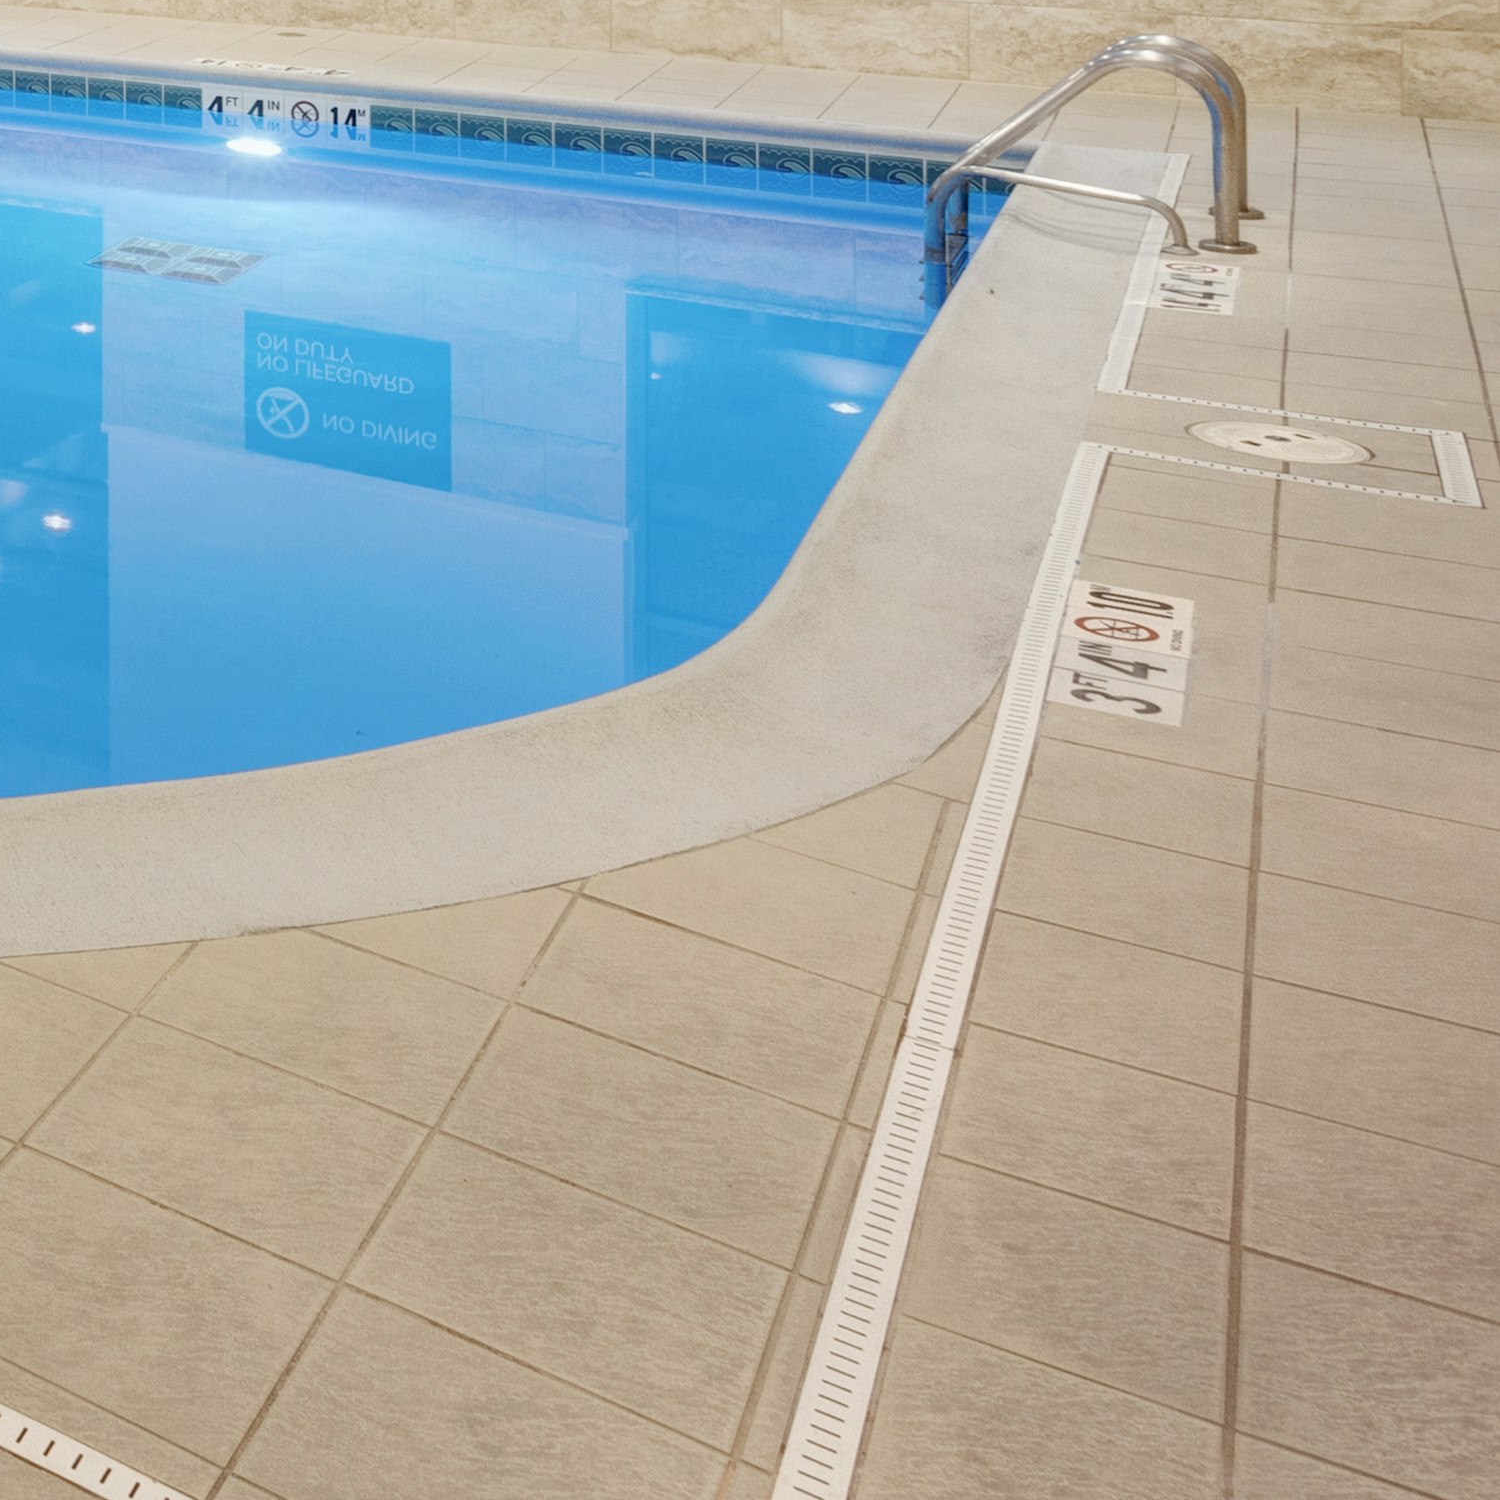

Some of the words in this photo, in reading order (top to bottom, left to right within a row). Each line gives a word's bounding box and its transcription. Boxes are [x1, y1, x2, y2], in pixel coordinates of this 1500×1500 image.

[208, 96, 223, 113] 4
[226, 96, 239, 107] FT
[248, 100, 263, 117] 4
[267, 100, 280, 110] IN
[1078, 653, 1167, 680] 4
[1073, 672, 1108, 690] FT
[1070, 688, 1162, 714] 3
